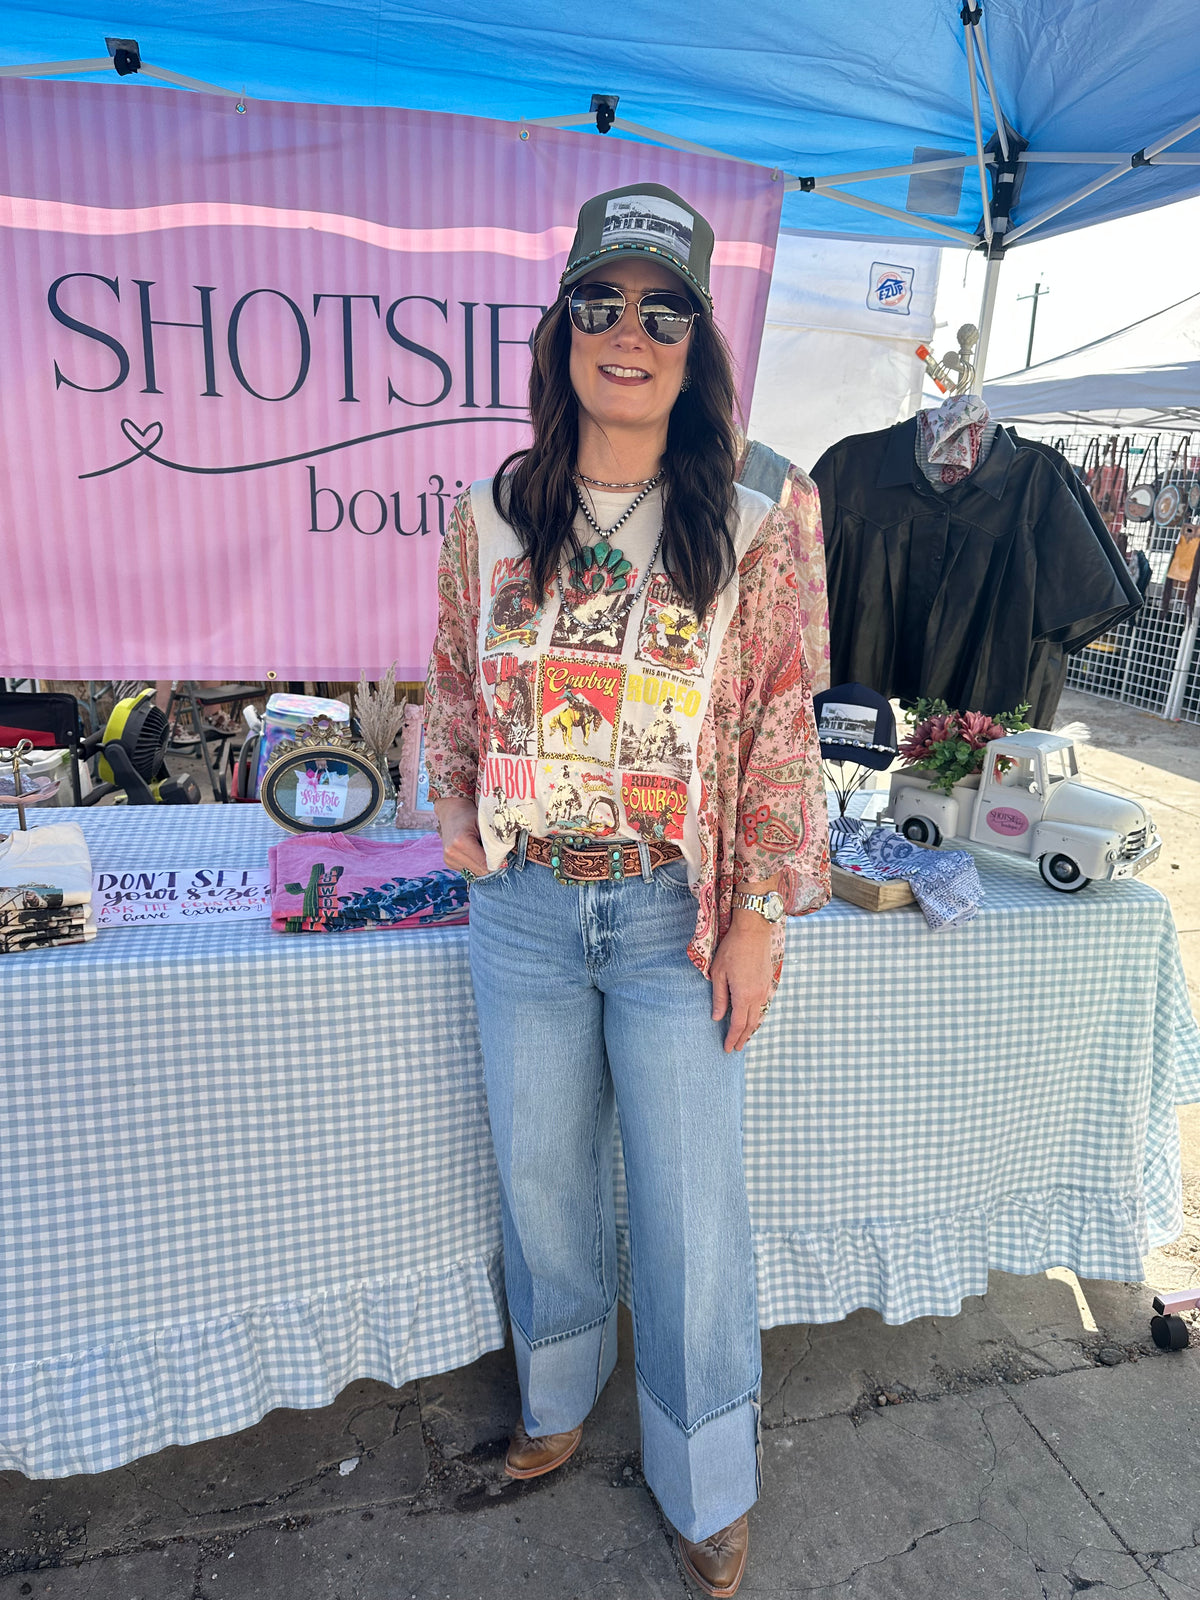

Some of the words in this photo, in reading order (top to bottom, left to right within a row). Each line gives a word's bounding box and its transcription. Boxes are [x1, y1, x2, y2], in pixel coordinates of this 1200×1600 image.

[546, 666, 618, 698] Cowboy
[642, 667, 655, 676] THIS
[679, 677, 695, 687] FIRST
[626, 673, 702, 718] RODEO
[631, 775, 658, 788] RIDE
[621, 786, 688, 815] COWBOY
[98, 871, 181, 891] DON'T
[191, 869, 265, 888] SEE
[104, 888, 179, 907] your
[101, 904, 134, 915] ASK
[144, 903, 171, 911] THE
[122, 912, 169, 921] have
[181, 905, 251, 917] extras
